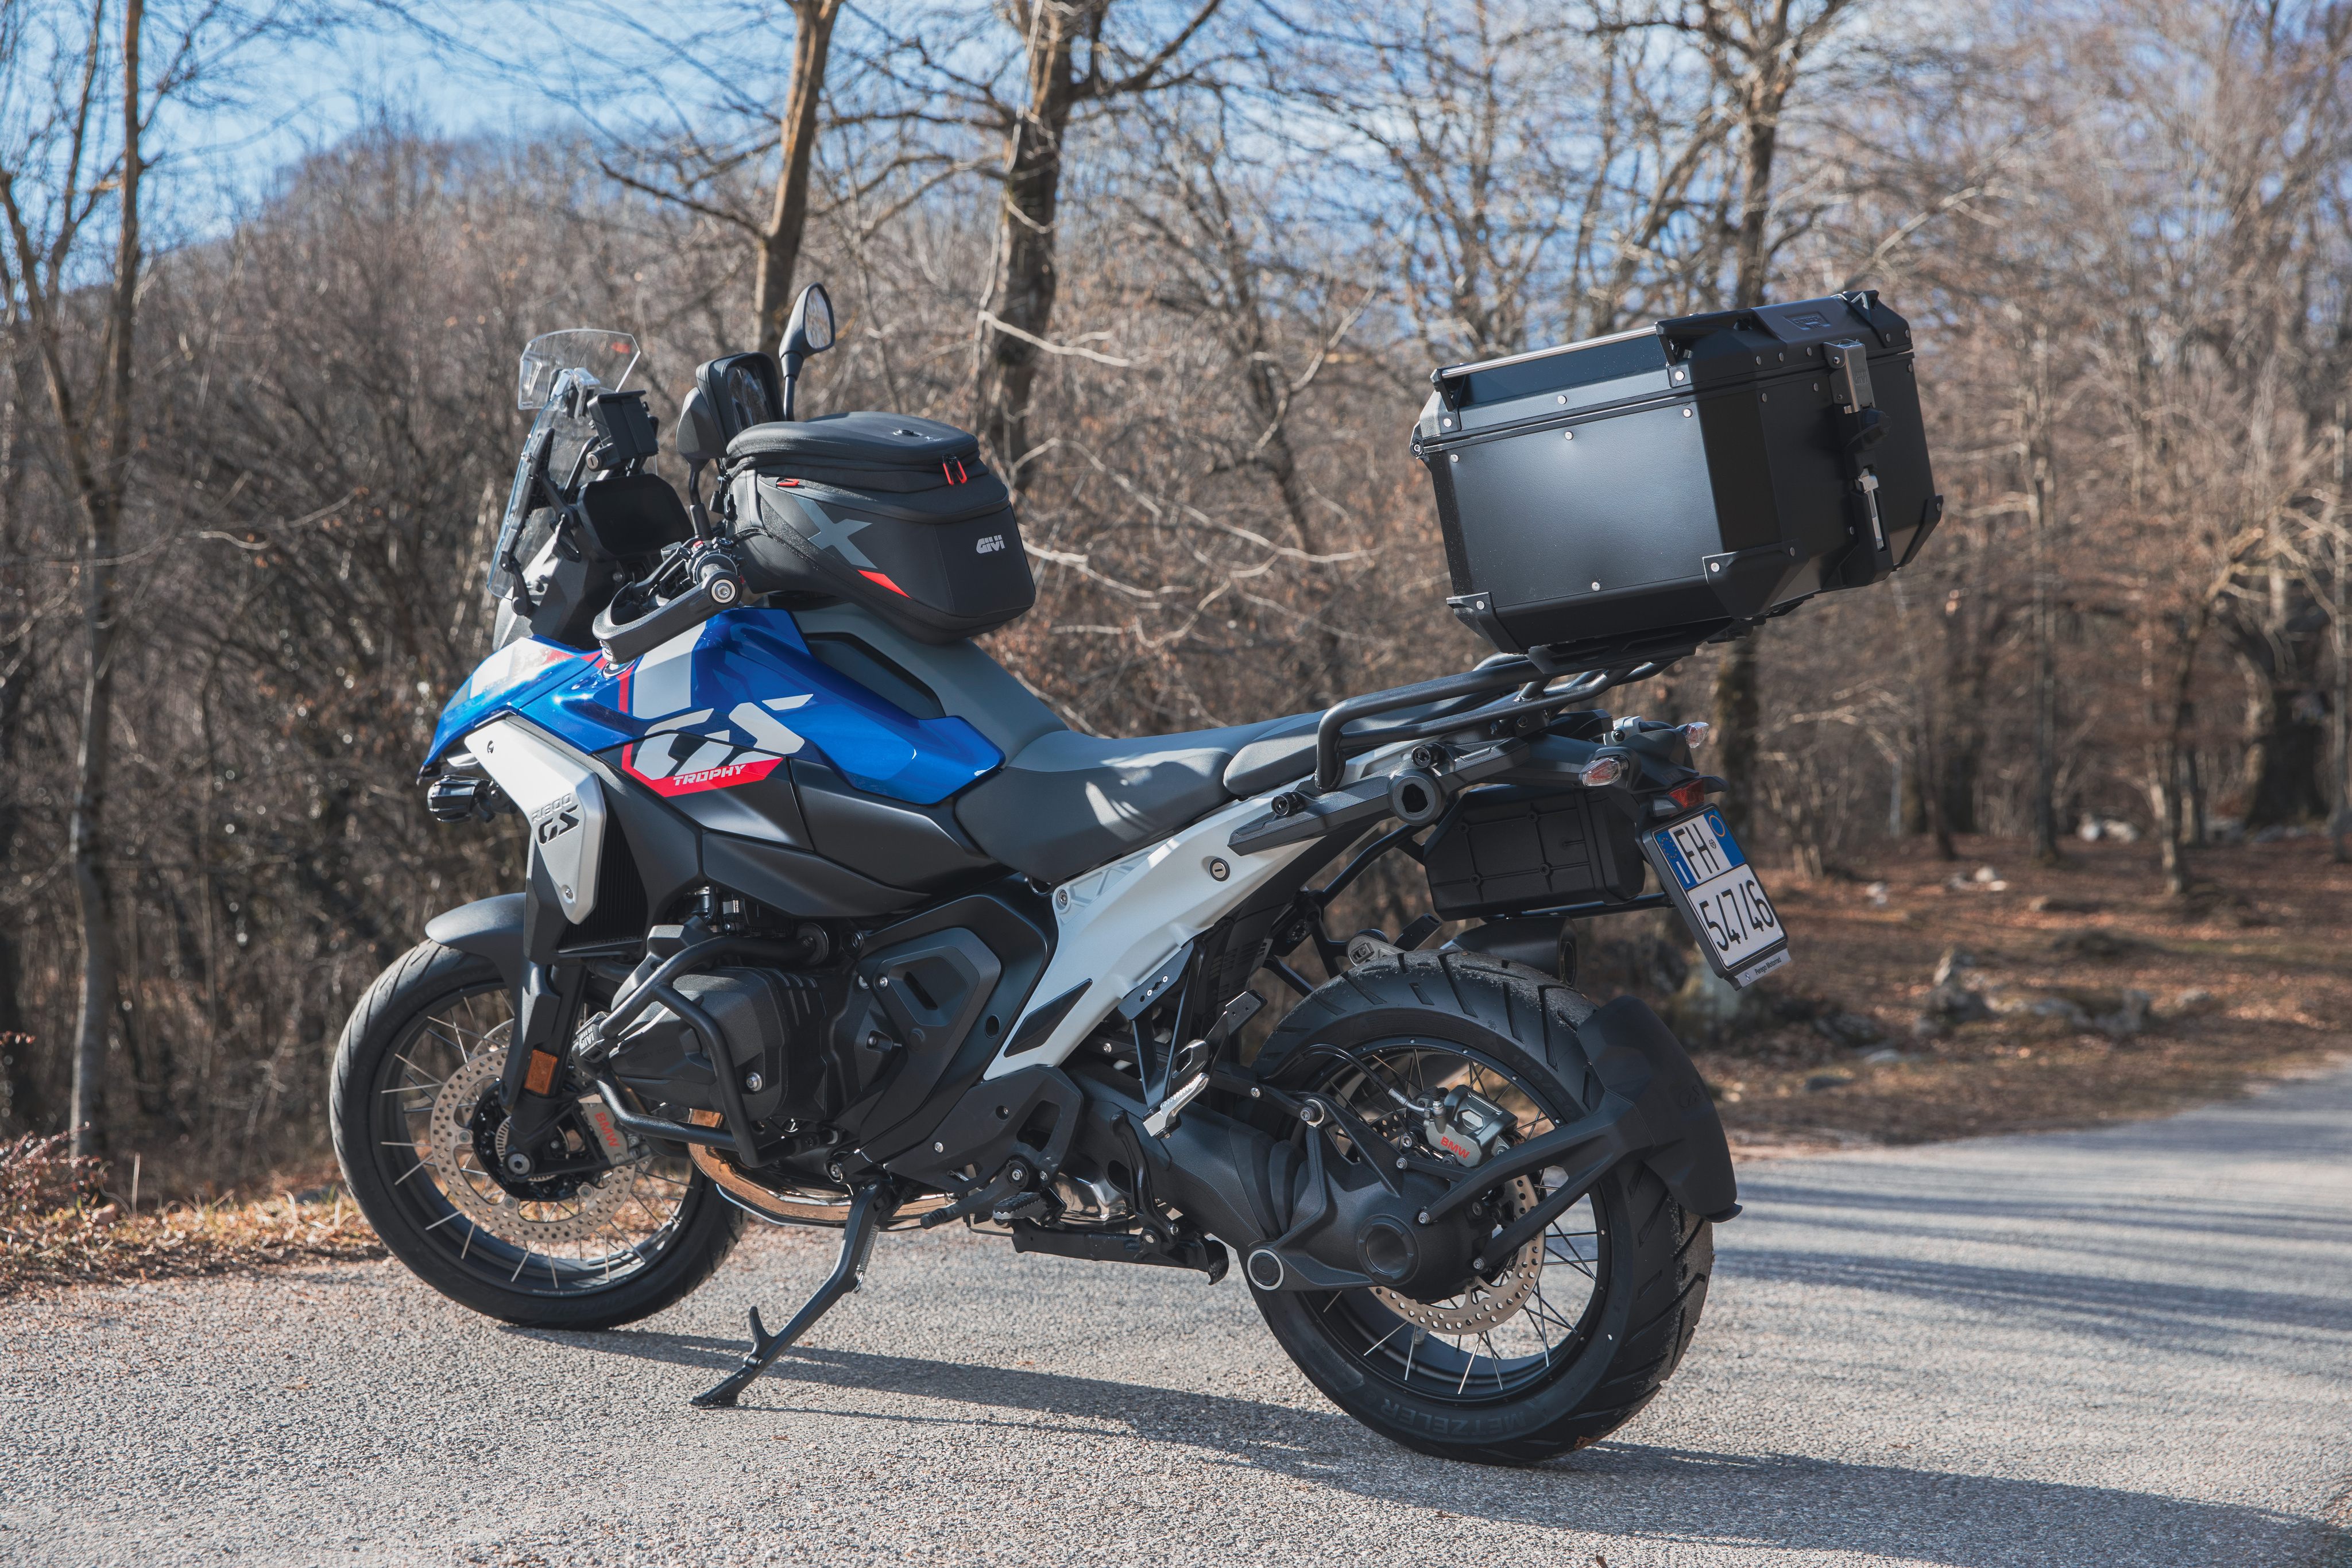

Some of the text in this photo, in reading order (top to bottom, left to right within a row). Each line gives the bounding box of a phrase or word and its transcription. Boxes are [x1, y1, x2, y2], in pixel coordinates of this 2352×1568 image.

[976, 535, 1005, 554] GIVI
[674, 765, 746, 786] TROPHY
[538, 804, 579, 846] GS
[1673, 822, 1720, 880] FH
[1699, 880, 1774, 951] 54746
[1754, 957, 1782, 975] Perego Motorrad
[579, 1025, 595, 1050] GIVI
[594, 1112, 621, 1147] BMW
[1440, 1136, 1471, 1159] BMW
